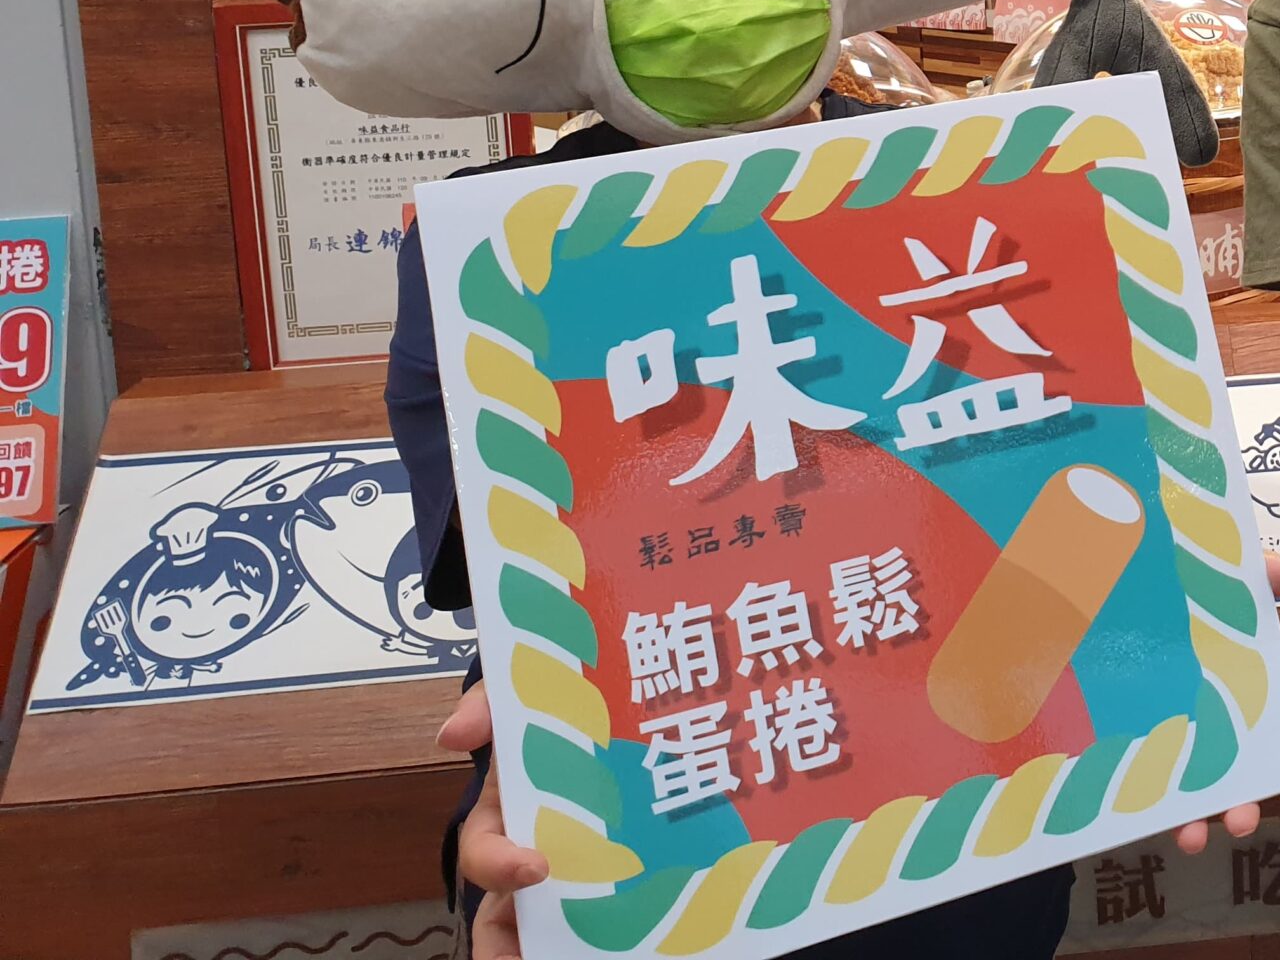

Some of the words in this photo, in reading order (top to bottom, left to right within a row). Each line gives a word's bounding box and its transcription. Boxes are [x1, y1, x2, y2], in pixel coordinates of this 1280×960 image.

[0, 244, 44, 290] 捲
[308, 236, 340, 252] 局長
[0, 307, 51, 392] 9
[606, 216, 1072, 485] 味益
[0, 465, 31, 498] 97
[639, 503, 806, 570] 鬆品專賣
[622, 546, 920, 703] 鮪魚鬆
[639, 677, 840, 815] 蛋捲
